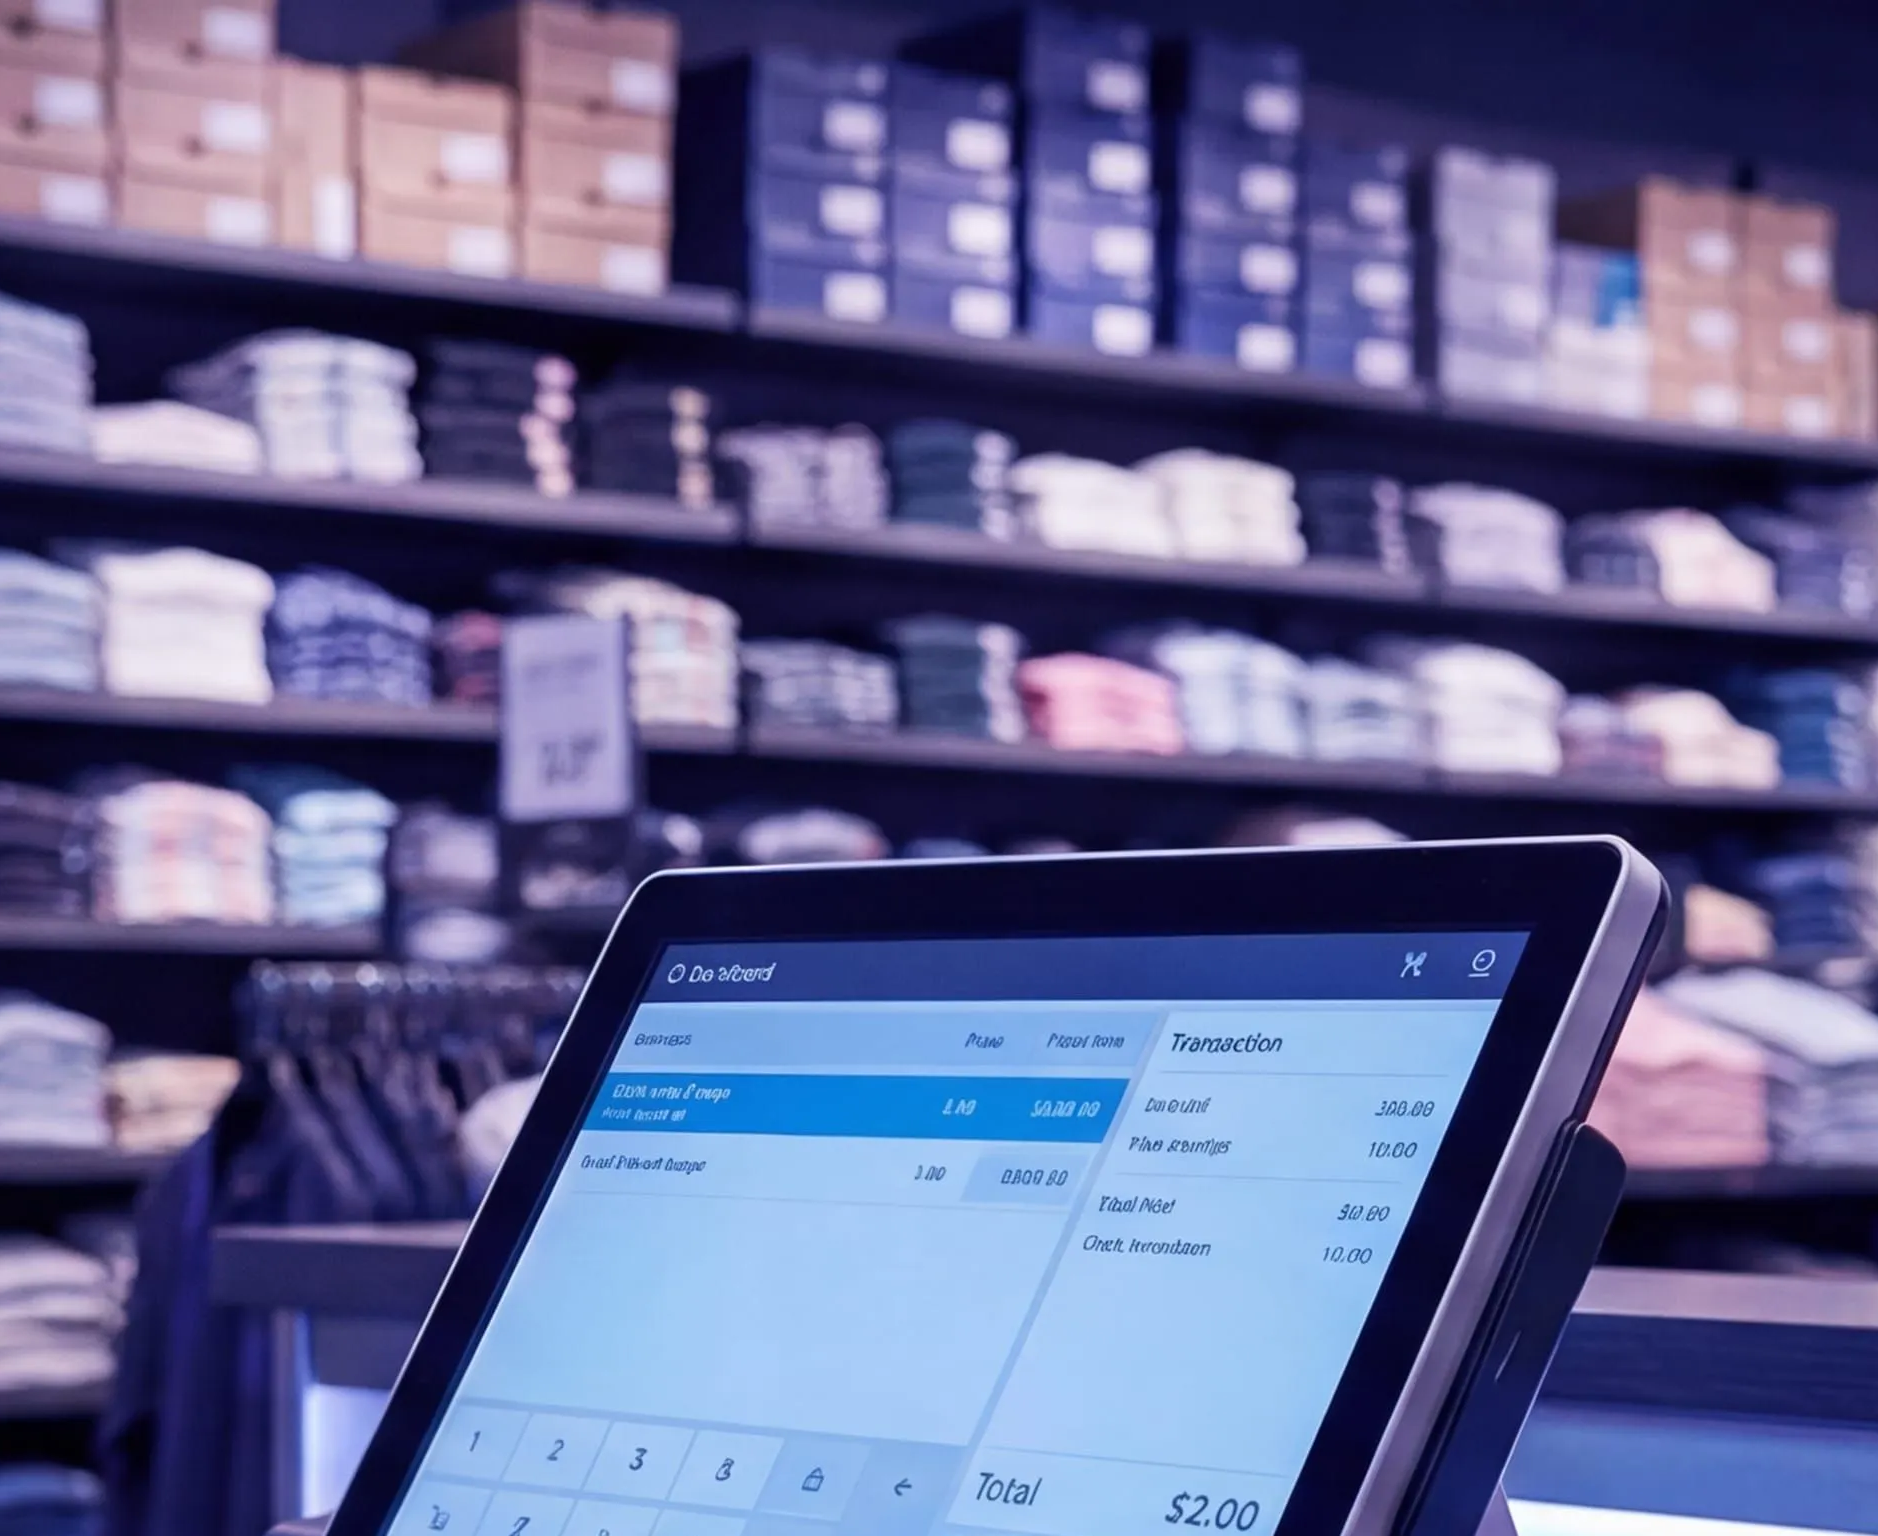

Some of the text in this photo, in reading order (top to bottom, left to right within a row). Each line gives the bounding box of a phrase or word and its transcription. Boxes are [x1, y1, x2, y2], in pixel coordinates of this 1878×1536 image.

[470, 1431, 481, 1452] 1
[547, 1439, 565, 1461] 2
[629, 1448, 648, 1471] 3
[976, 1472, 1042, 1506] Total
[1165, 1491, 1261, 1532] $2.00
